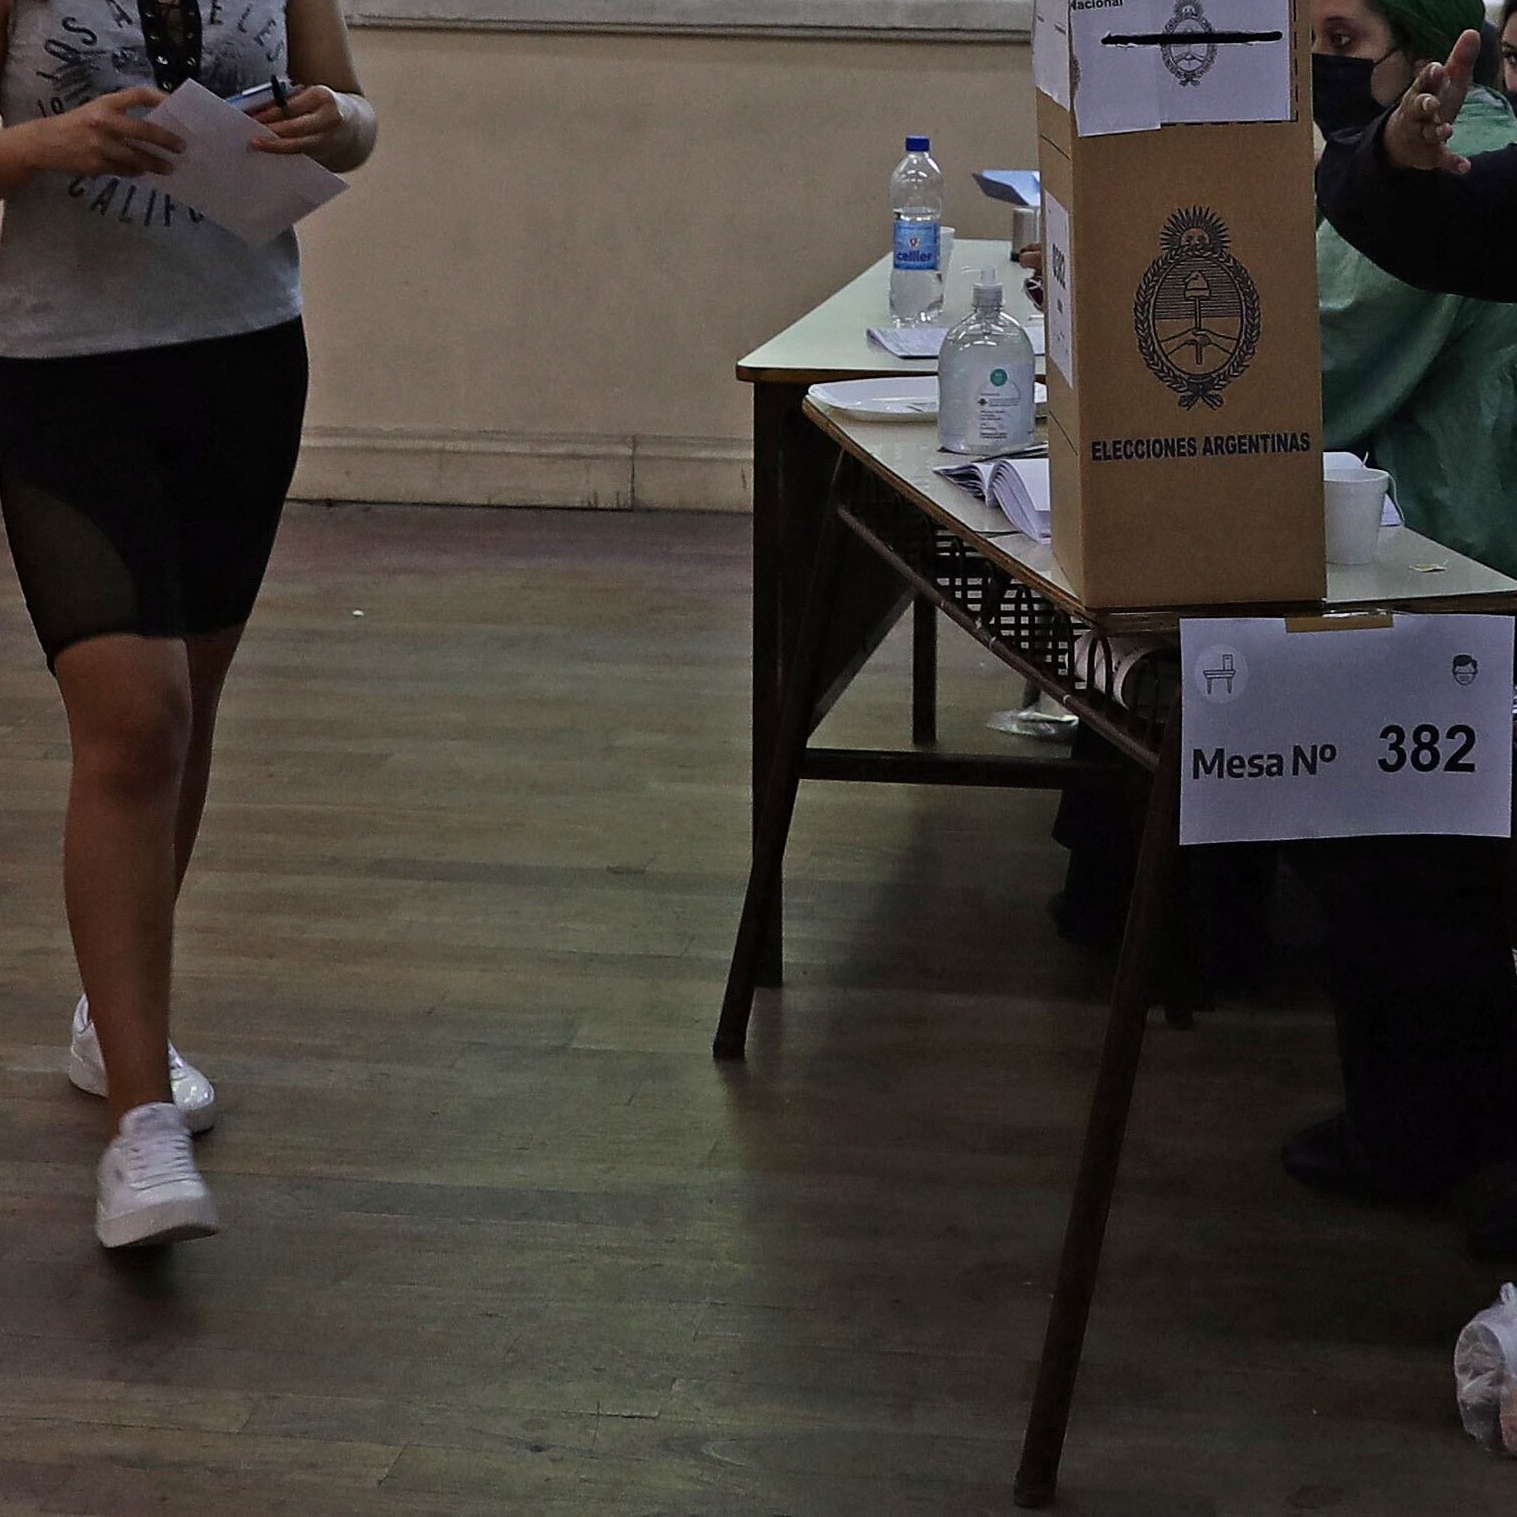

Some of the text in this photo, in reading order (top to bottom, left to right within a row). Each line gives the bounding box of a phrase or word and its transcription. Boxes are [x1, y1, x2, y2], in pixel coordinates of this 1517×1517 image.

[1091, 432, 1311, 461] ELECCIONES ARGENTINAS
[1192, 747, 1283, 779] Mesa
[1377, 723, 1476, 773] 382
